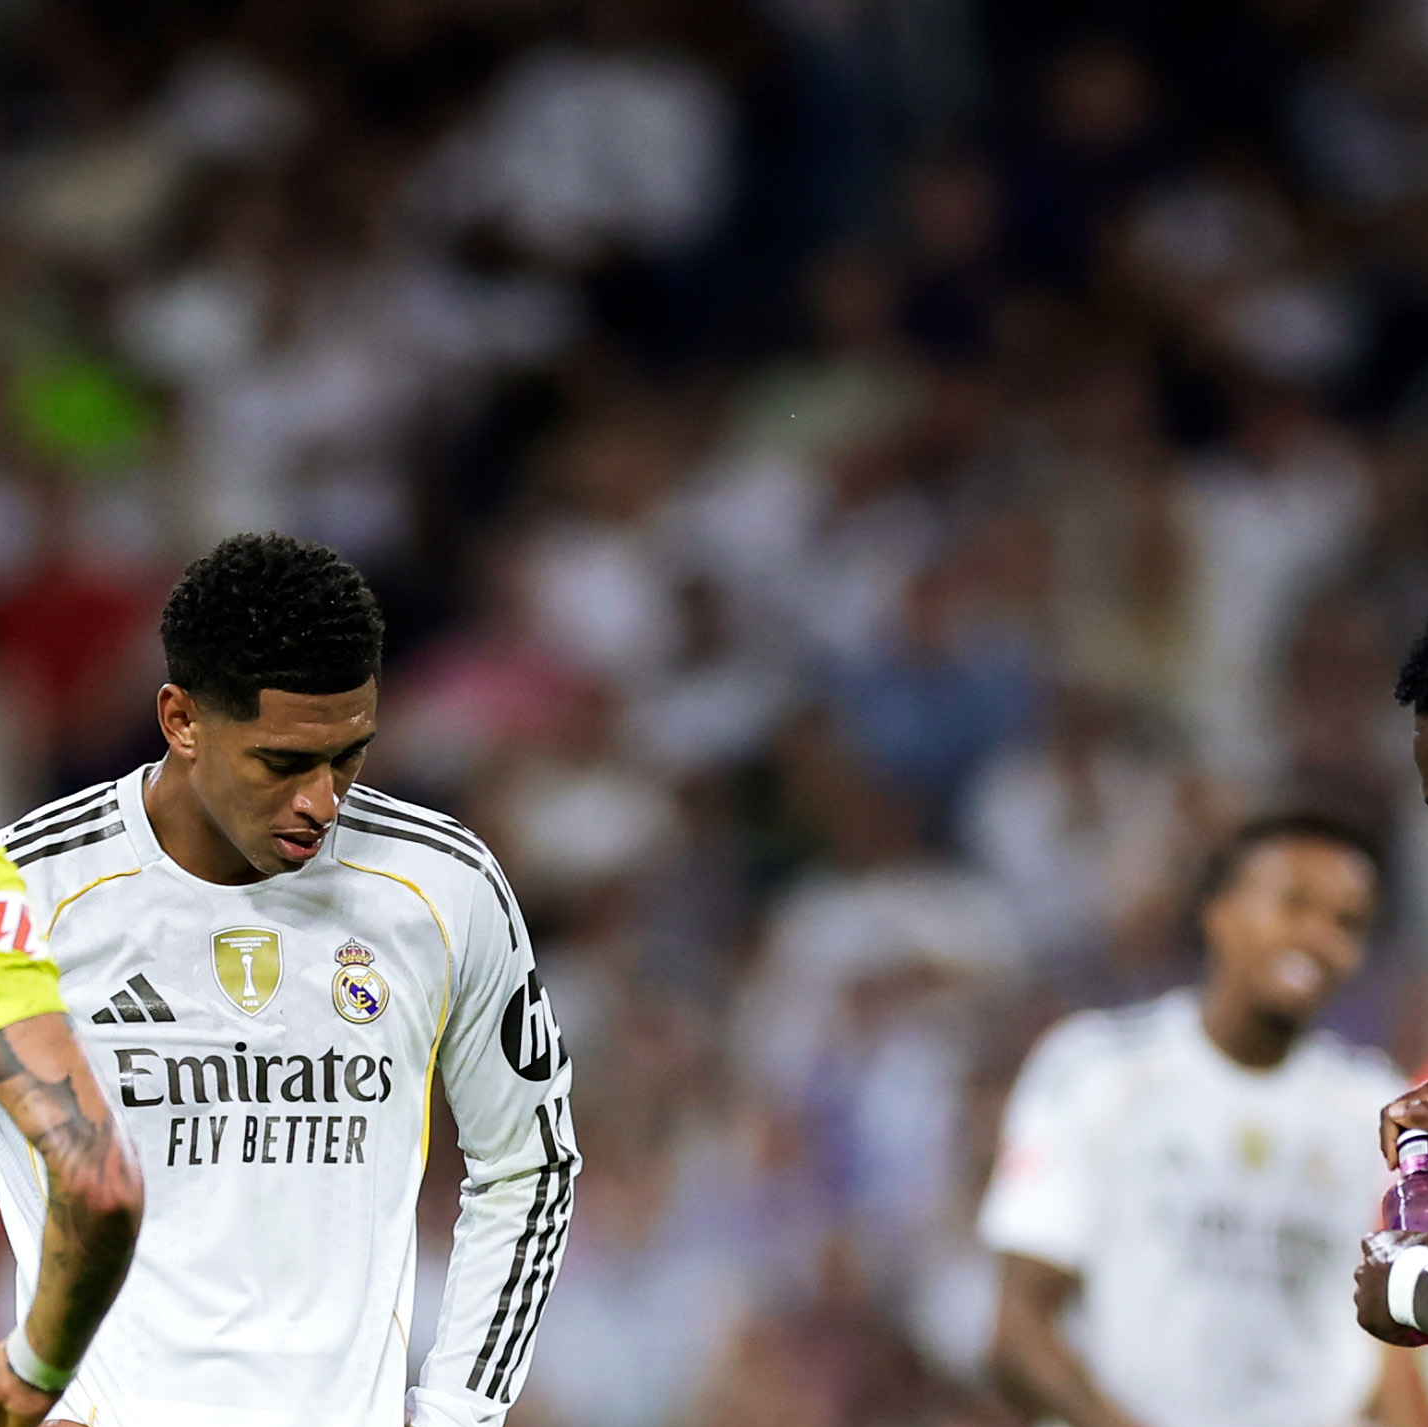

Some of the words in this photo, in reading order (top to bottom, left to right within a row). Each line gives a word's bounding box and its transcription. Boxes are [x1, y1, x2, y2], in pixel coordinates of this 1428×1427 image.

[115, 1041, 393, 1108] Emirates
[166, 1116, 229, 1168] FLY
[241, 1114, 368, 1165] BETTER
